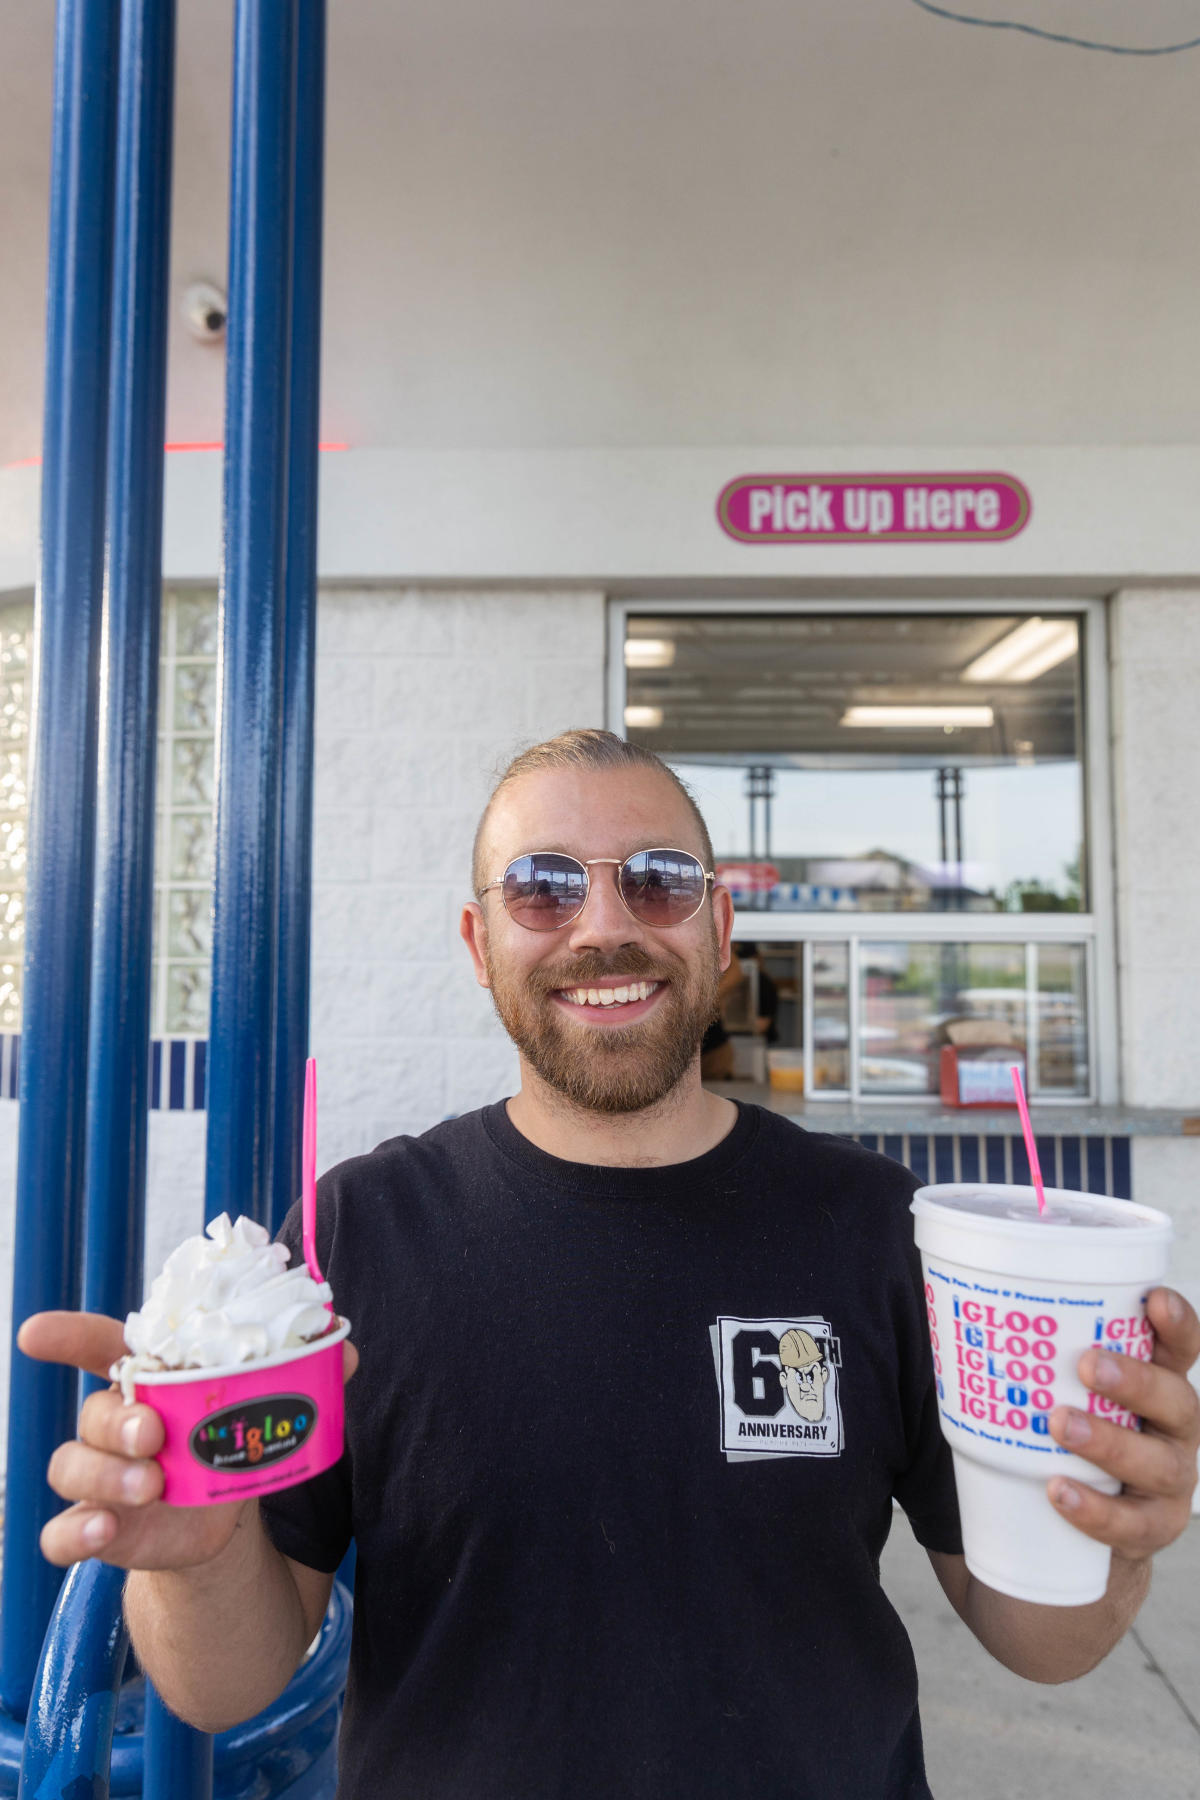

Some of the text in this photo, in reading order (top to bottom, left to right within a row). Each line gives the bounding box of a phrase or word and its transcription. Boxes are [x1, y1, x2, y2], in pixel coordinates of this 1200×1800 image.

[750, 485, 1001, 534] Pick Up Here
[952, 1294, 1058, 1337] IGLOO
[953, 1319, 1057, 1361] IGLOO
[956, 1343, 1056, 1386] IGLOO
[957, 1367, 1055, 1411] IGLOO
[738, 1422, 828, 1440] ANNIVERSARY
[959, 1392, 1051, 1435] IGLOO
[234, 1413, 308, 1464] igloo
